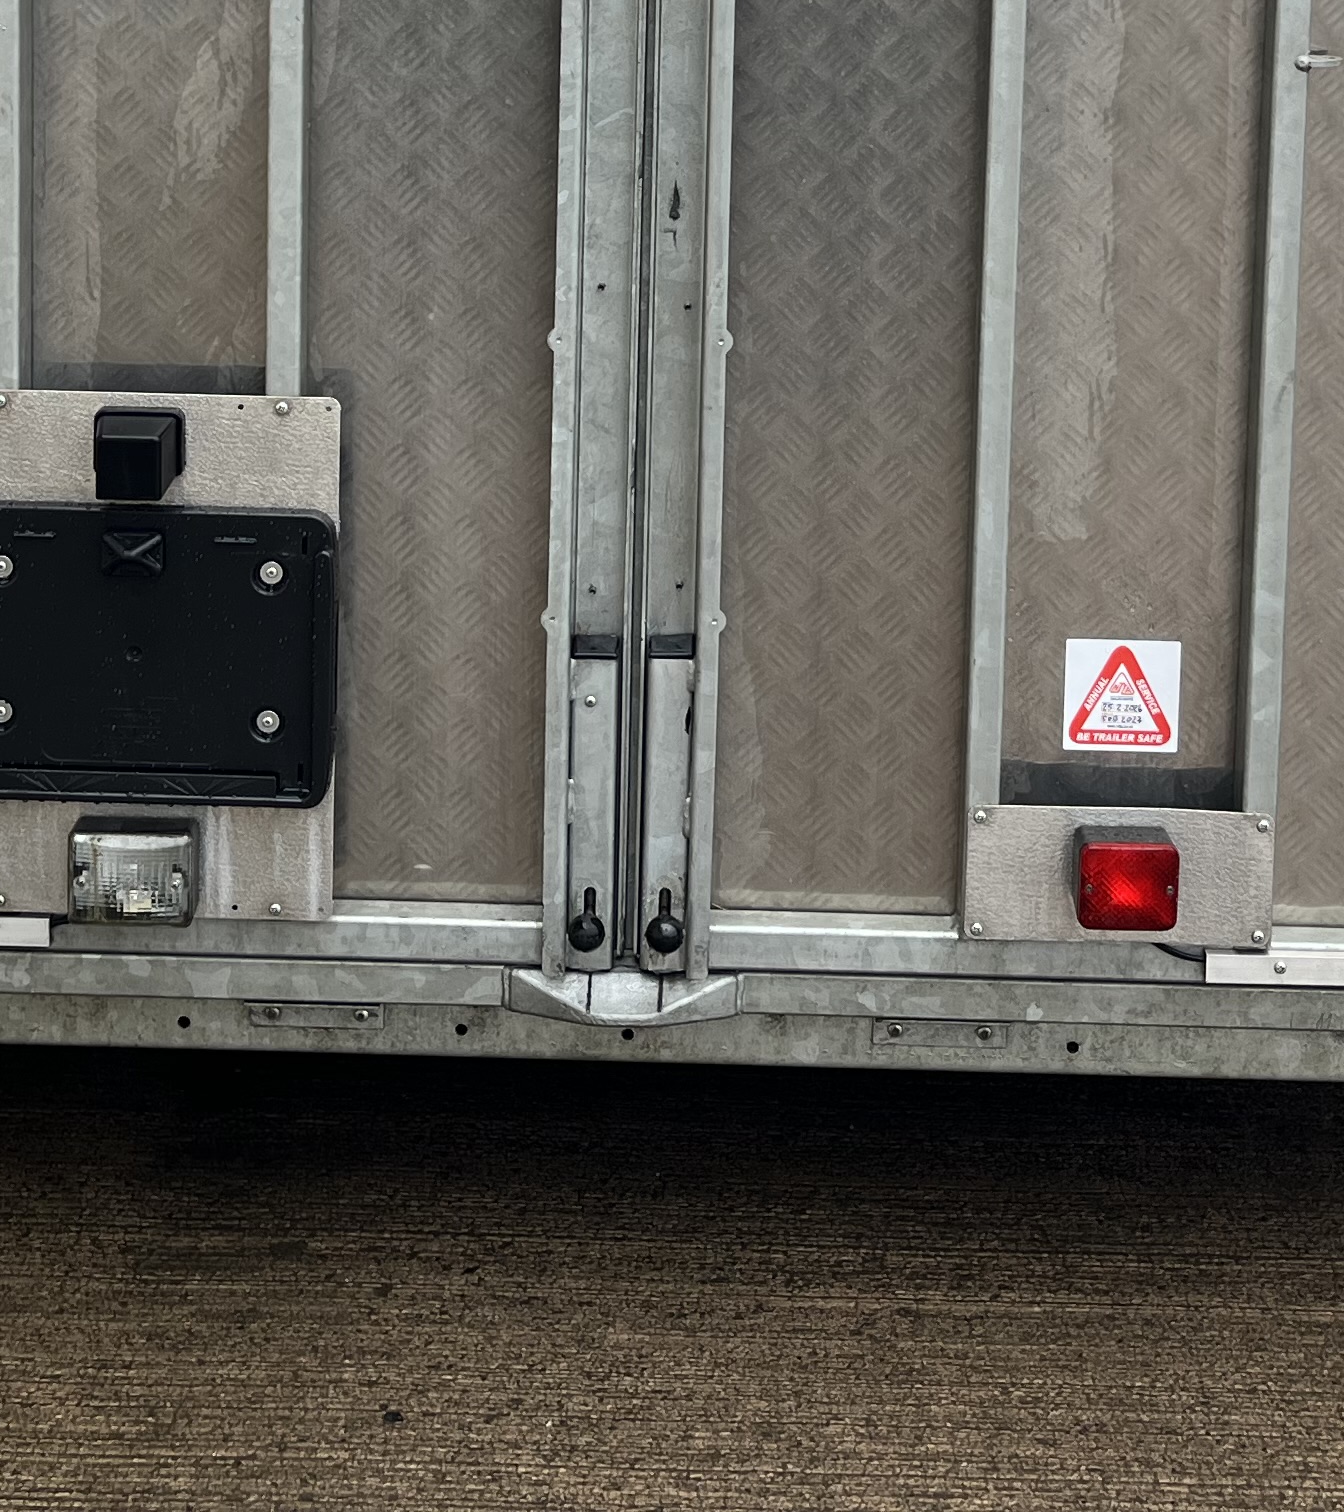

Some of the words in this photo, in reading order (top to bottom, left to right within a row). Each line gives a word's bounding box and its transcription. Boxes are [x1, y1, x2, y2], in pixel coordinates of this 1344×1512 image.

[1083, 676, 1109, 711] ANNUAL
[1136, 678, 1161, 715] SERVICE
[1076, 732, 1090, 741] BE
[1092, 732, 1135, 742] TRAILER
[1137, 733, 1163, 743] SAFE
